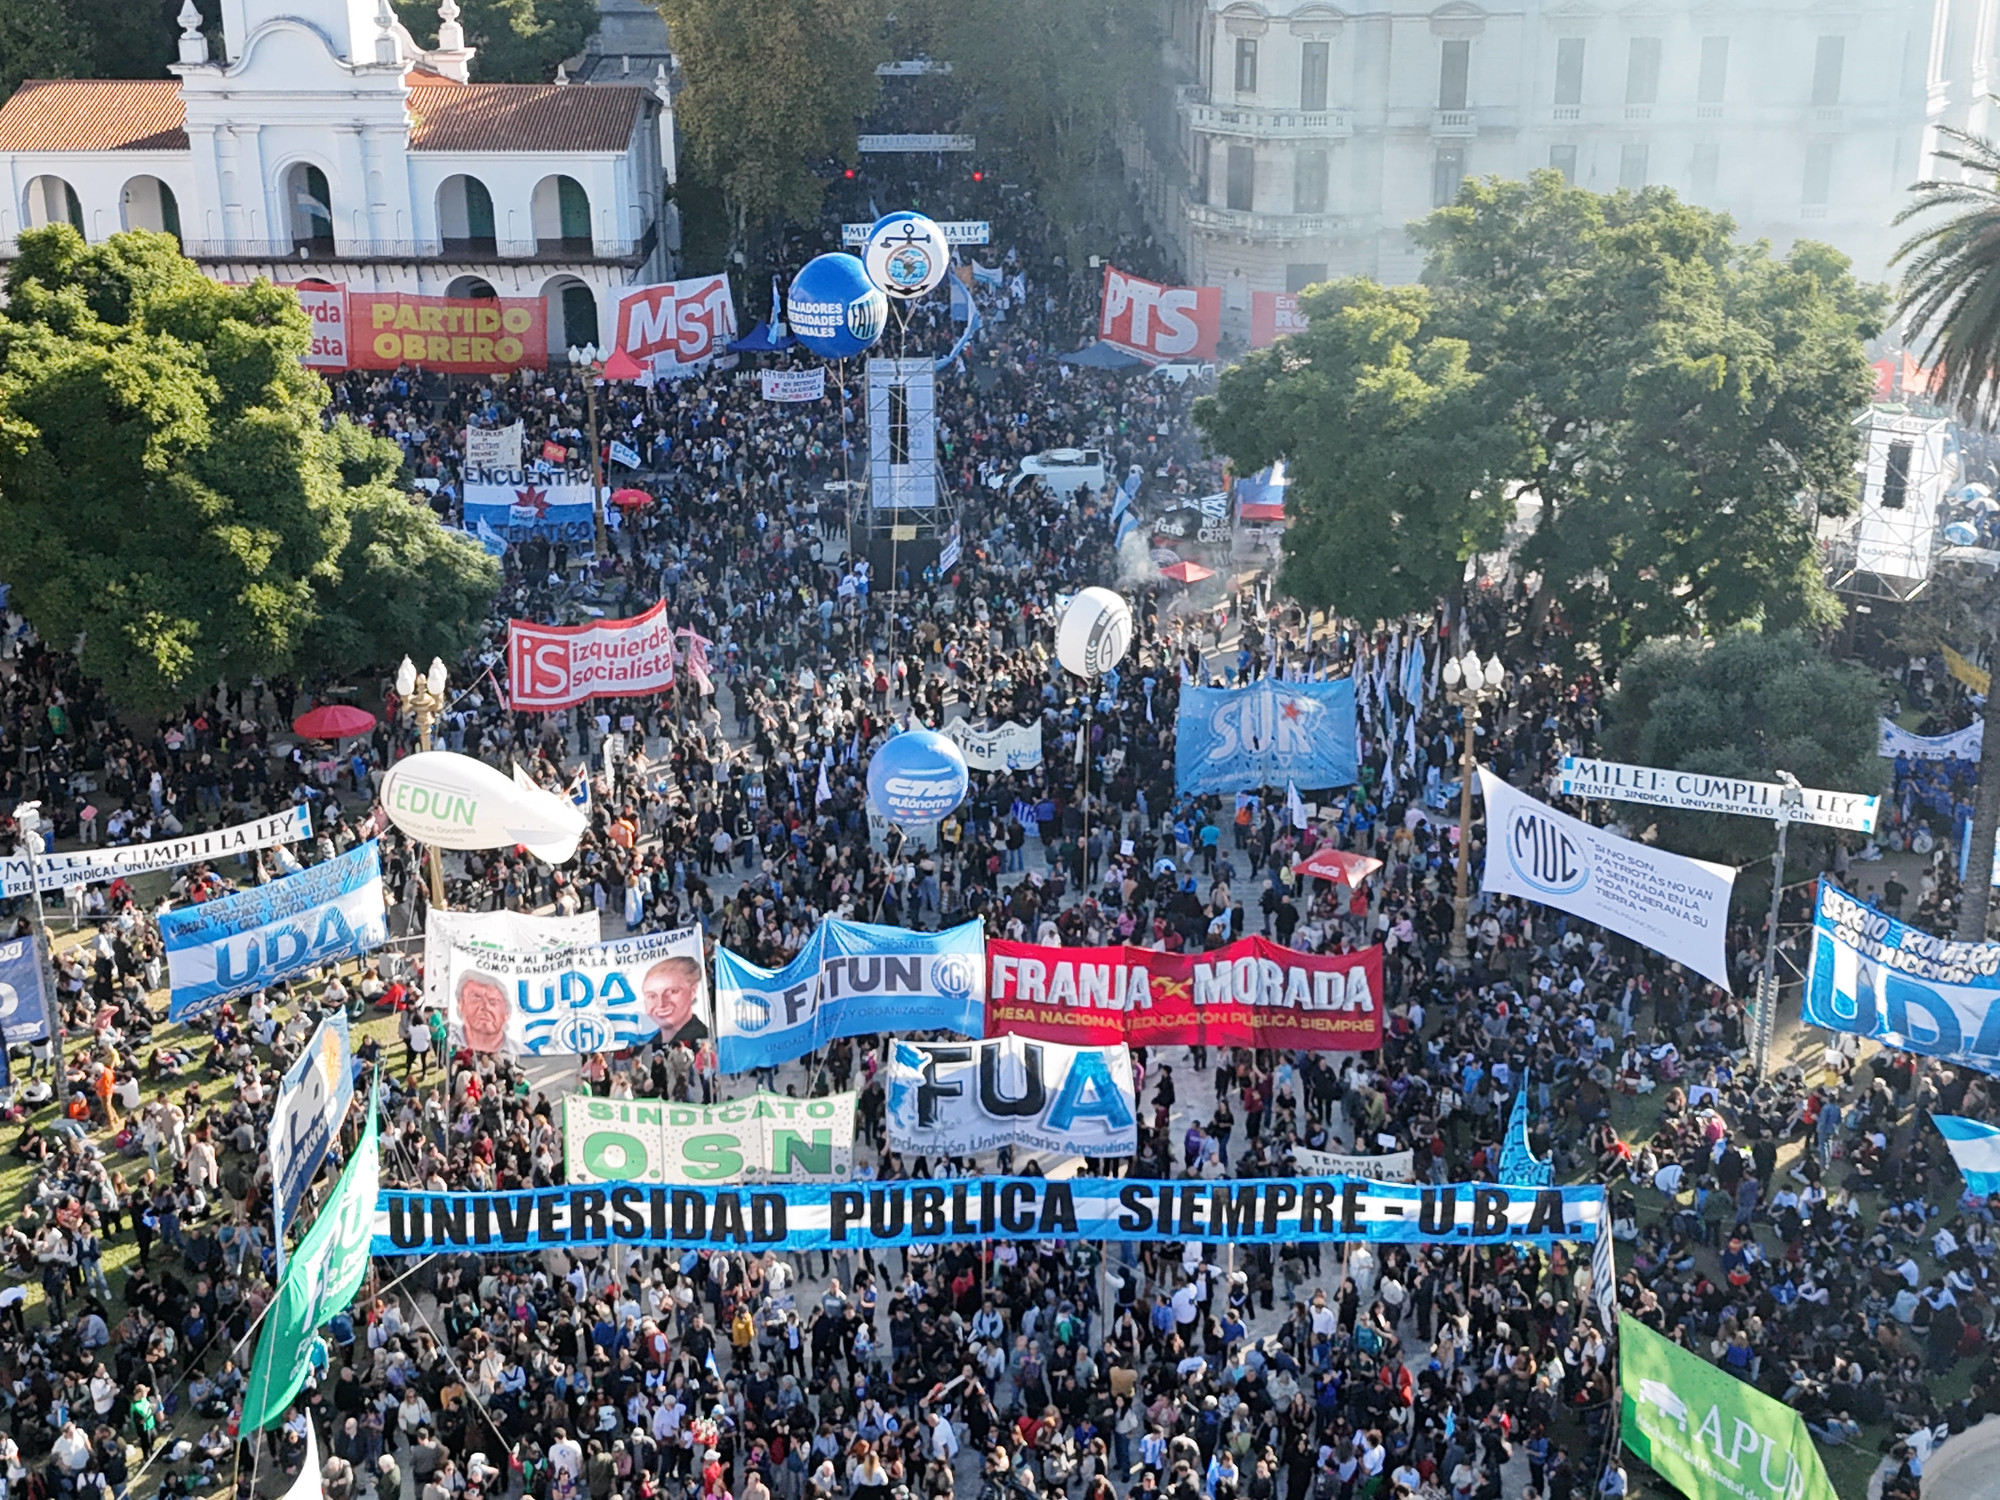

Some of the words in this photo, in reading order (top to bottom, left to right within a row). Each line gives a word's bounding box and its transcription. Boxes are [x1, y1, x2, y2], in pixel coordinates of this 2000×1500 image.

[372, 303, 532, 333] PARTIDO
[1103, 272, 1199, 354] PTS
[373, 332, 523, 363] OBRERO
[464, 466, 592, 486] ENCUENTRO
[572, 625, 668, 663] izquierda
[572, 652, 671, 687] socialista
[396, 783, 477, 826] EDUN
[1573, 782, 1616, 797] FRENTE
[1624, 790, 1674, 804] SINDICAL
[1680, 797, 1775, 816] UNIVERSITARIO
[1790, 809, 1815, 822] CIN
[1827, 814, 1855, 827] FUA
[1574, 761, 1666, 791] MILEI:
[1675, 775, 1768, 806] CUMPLI
[1816, 793, 1858, 813] LEY
[221, 830, 247, 850] LA
[257, 813, 295, 840] LEY
[1515, 815, 1578, 883] MUC
[1607, 848, 1625, 861] NO
[62, 866, 118, 885] SINDICAL
[1594, 853, 1665, 887] PATRIOTAS
[1667, 881, 1686, 893] NO
[1687, 886, 1714, 901] VAN
[1606, 869, 1629, 884] SER
[1630, 879, 1666, 899] NADA
[1668, 893, 1684, 905] EN
[1685, 899, 1701, 911] LA
[1628, 889, 1681, 918] QUIERAN
[1692, 915, 1709, 928] SU
[1821, 885, 1890, 940] SERGIO
[216, 904, 356, 988] UDA
[476, 959, 509, 974] COMO
[516, 958, 573, 974] BANDERA
[578, 958, 588, 967] A
[592, 958, 608, 967] LA
[615, 947, 669, 965] VICTORIA
[523, 955, 537, 964] MI
[601, 945, 609, 956] Y
[615, 943, 631, 954] LO
[518, 971, 636, 1014] UDA
[991, 954, 1153, 1012] FRANJA
[1193, 956, 1374, 1012] MORADA
[992, 1007, 1036, 1023] MESA
[1040, 1010, 1125, 1032] NACIONAL
[1301, 1017, 1376, 1032] SIEMPRE
[917, 1042, 1134, 1131] FUA
[587, 1100, 835, 1126] SINDICATO
[388, 1186, 787, 1248] UNIVERSIDAD
[830, 1183, 1078, 1243] PUBLICA
[1118, 1182, 1369, 1238] SIEMPRE
[1701, 1461, 1745, 1496] Personal
